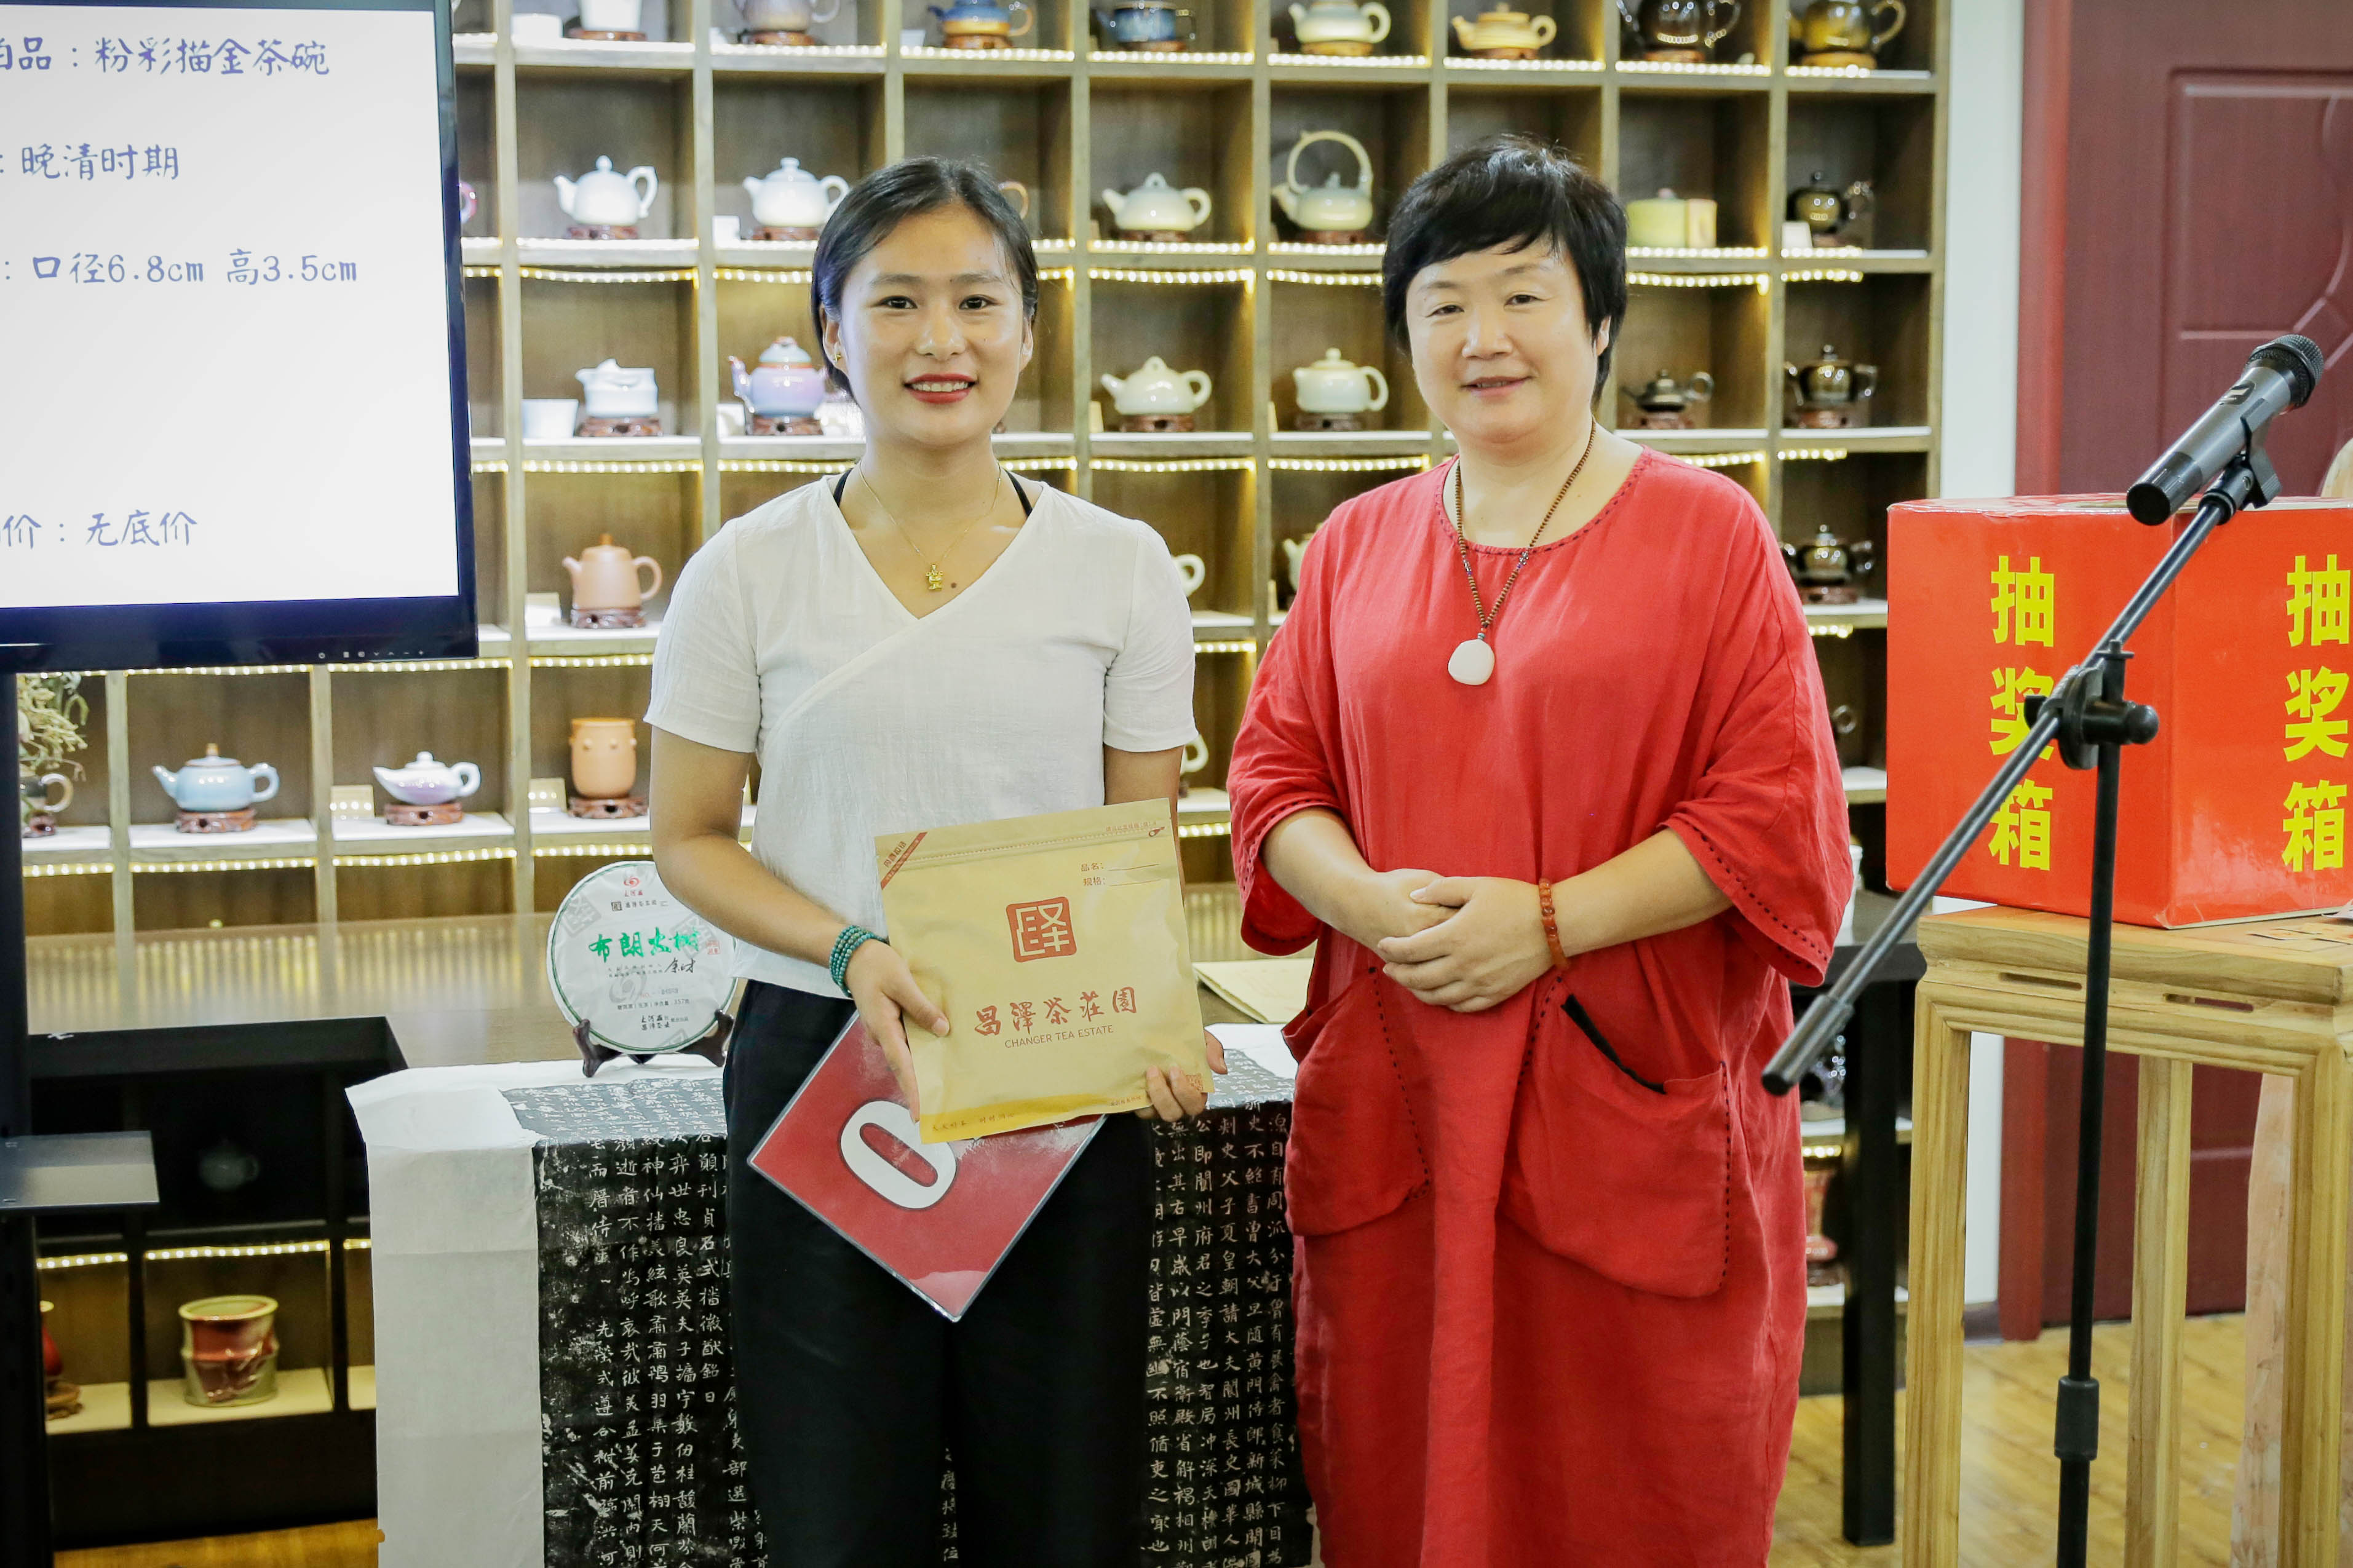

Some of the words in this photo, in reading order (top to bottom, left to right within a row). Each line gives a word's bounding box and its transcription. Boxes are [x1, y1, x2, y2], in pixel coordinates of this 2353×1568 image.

[2282, 554, 2351, 873] 抽奖箱
[1004, 1034, 1052, 1049] CHANGER
[1055, 1030, 1076, 1042] TEA
[1077, 1024, 1114, 1038] ESTATE
